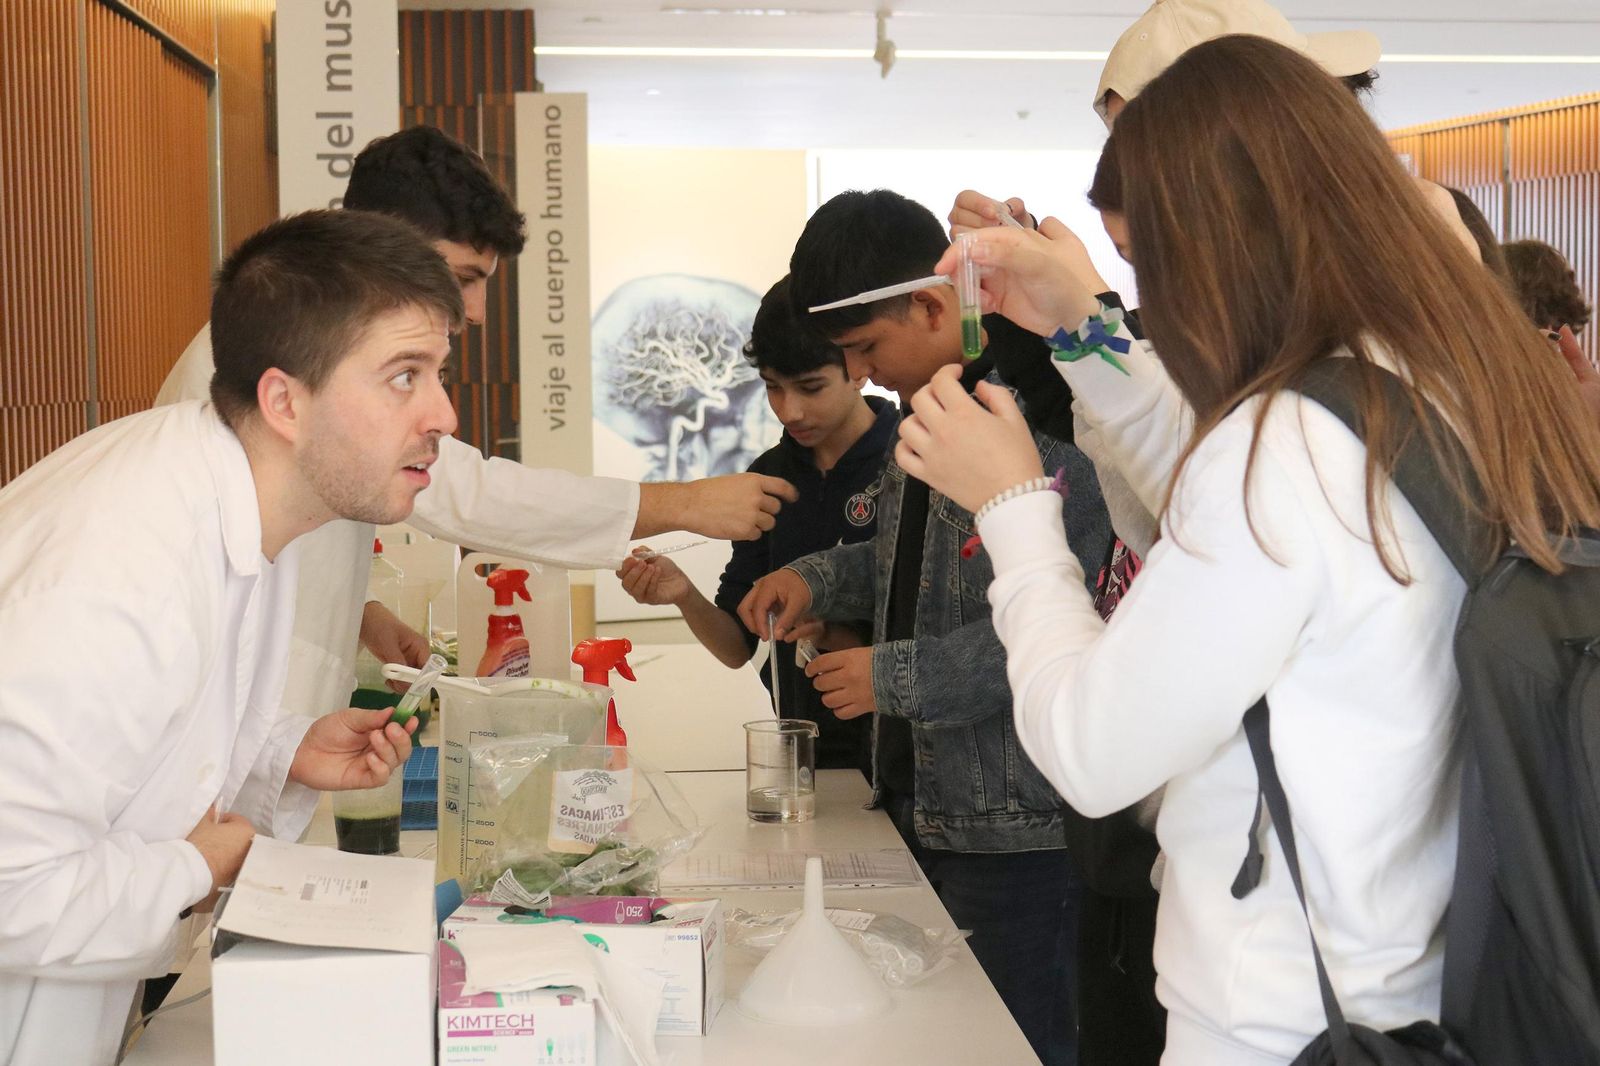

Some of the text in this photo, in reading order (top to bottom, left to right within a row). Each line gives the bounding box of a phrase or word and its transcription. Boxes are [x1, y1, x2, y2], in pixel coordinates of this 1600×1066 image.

[324, 0, 352, 92] mus
[315, 111, 354, 178] del
[540, 104, 572, 431] viaje al cuerpo humano
[850, 495, 872, 504] PARIS
[626, 906, 643, 917] 250
[447, 1014, 534, 1029] KIMTECH
[447, 1045, 470, 1053] GREEN
